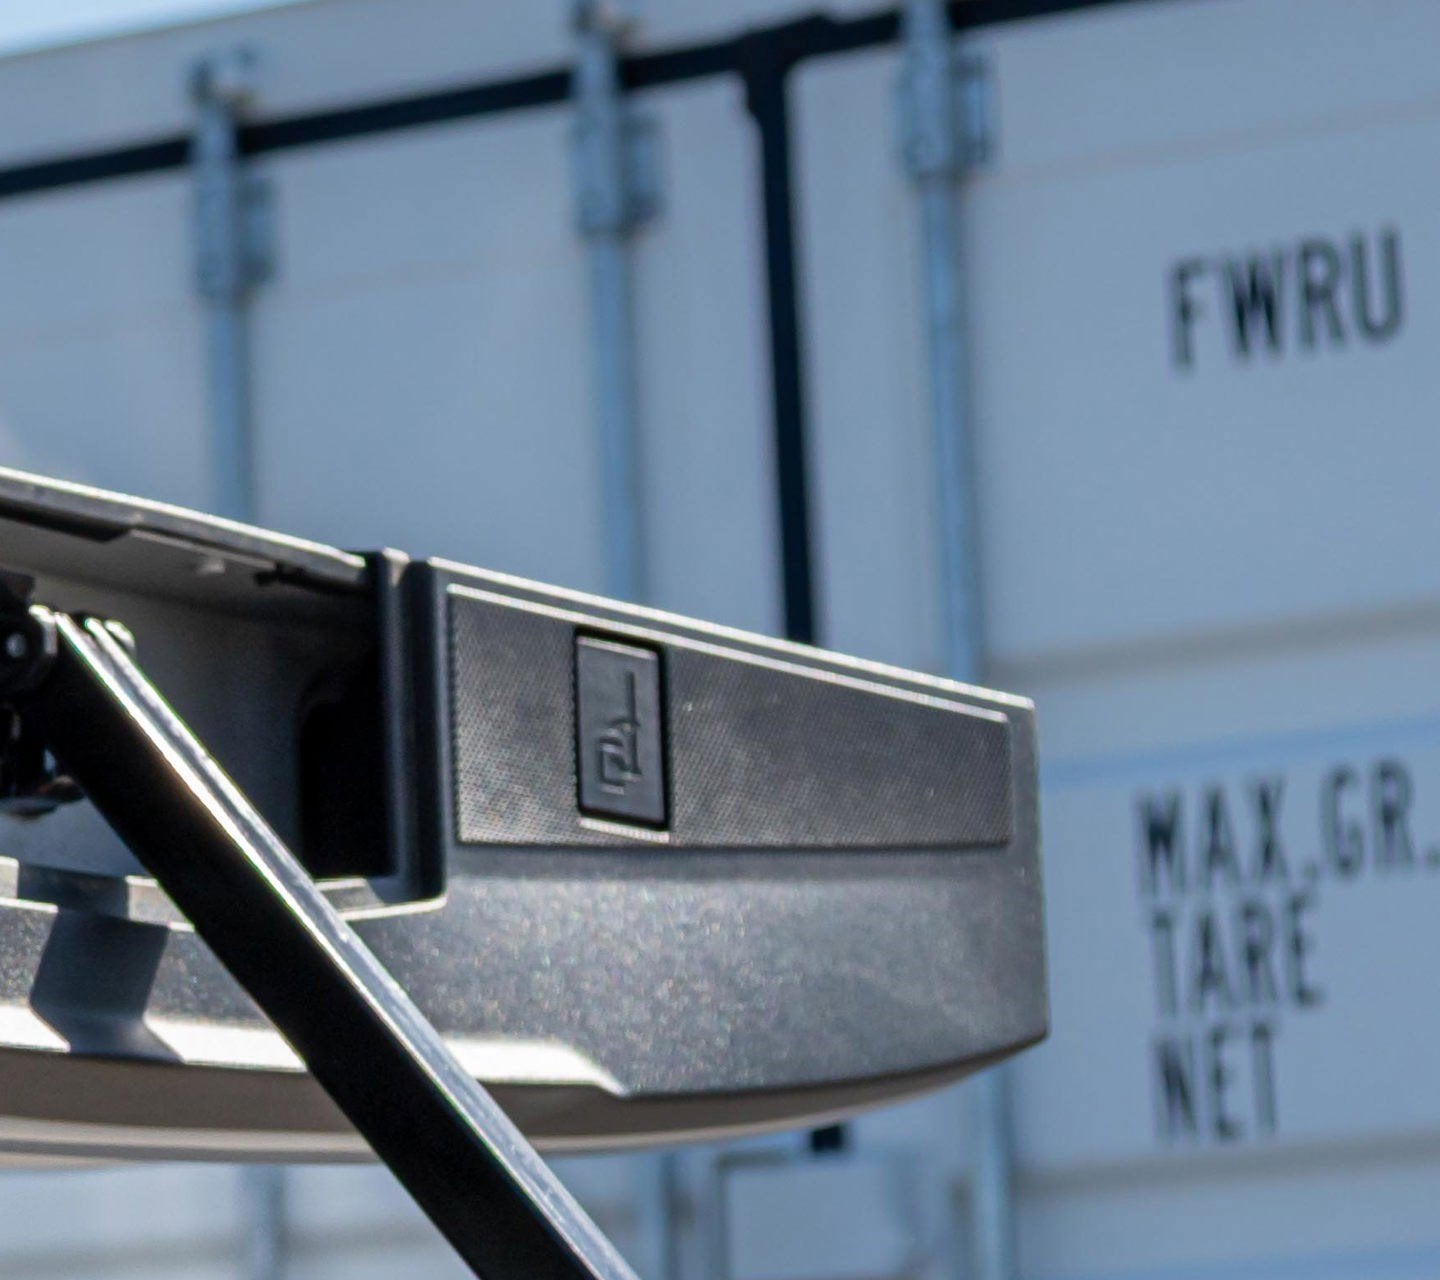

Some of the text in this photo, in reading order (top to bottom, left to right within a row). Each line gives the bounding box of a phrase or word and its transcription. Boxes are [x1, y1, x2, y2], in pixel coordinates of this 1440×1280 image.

[1166, 223, 1404, 376] FWRU
[1150, 886, 1324, 1016] TARE
[1150, 1022, 1278, 1144] NET
